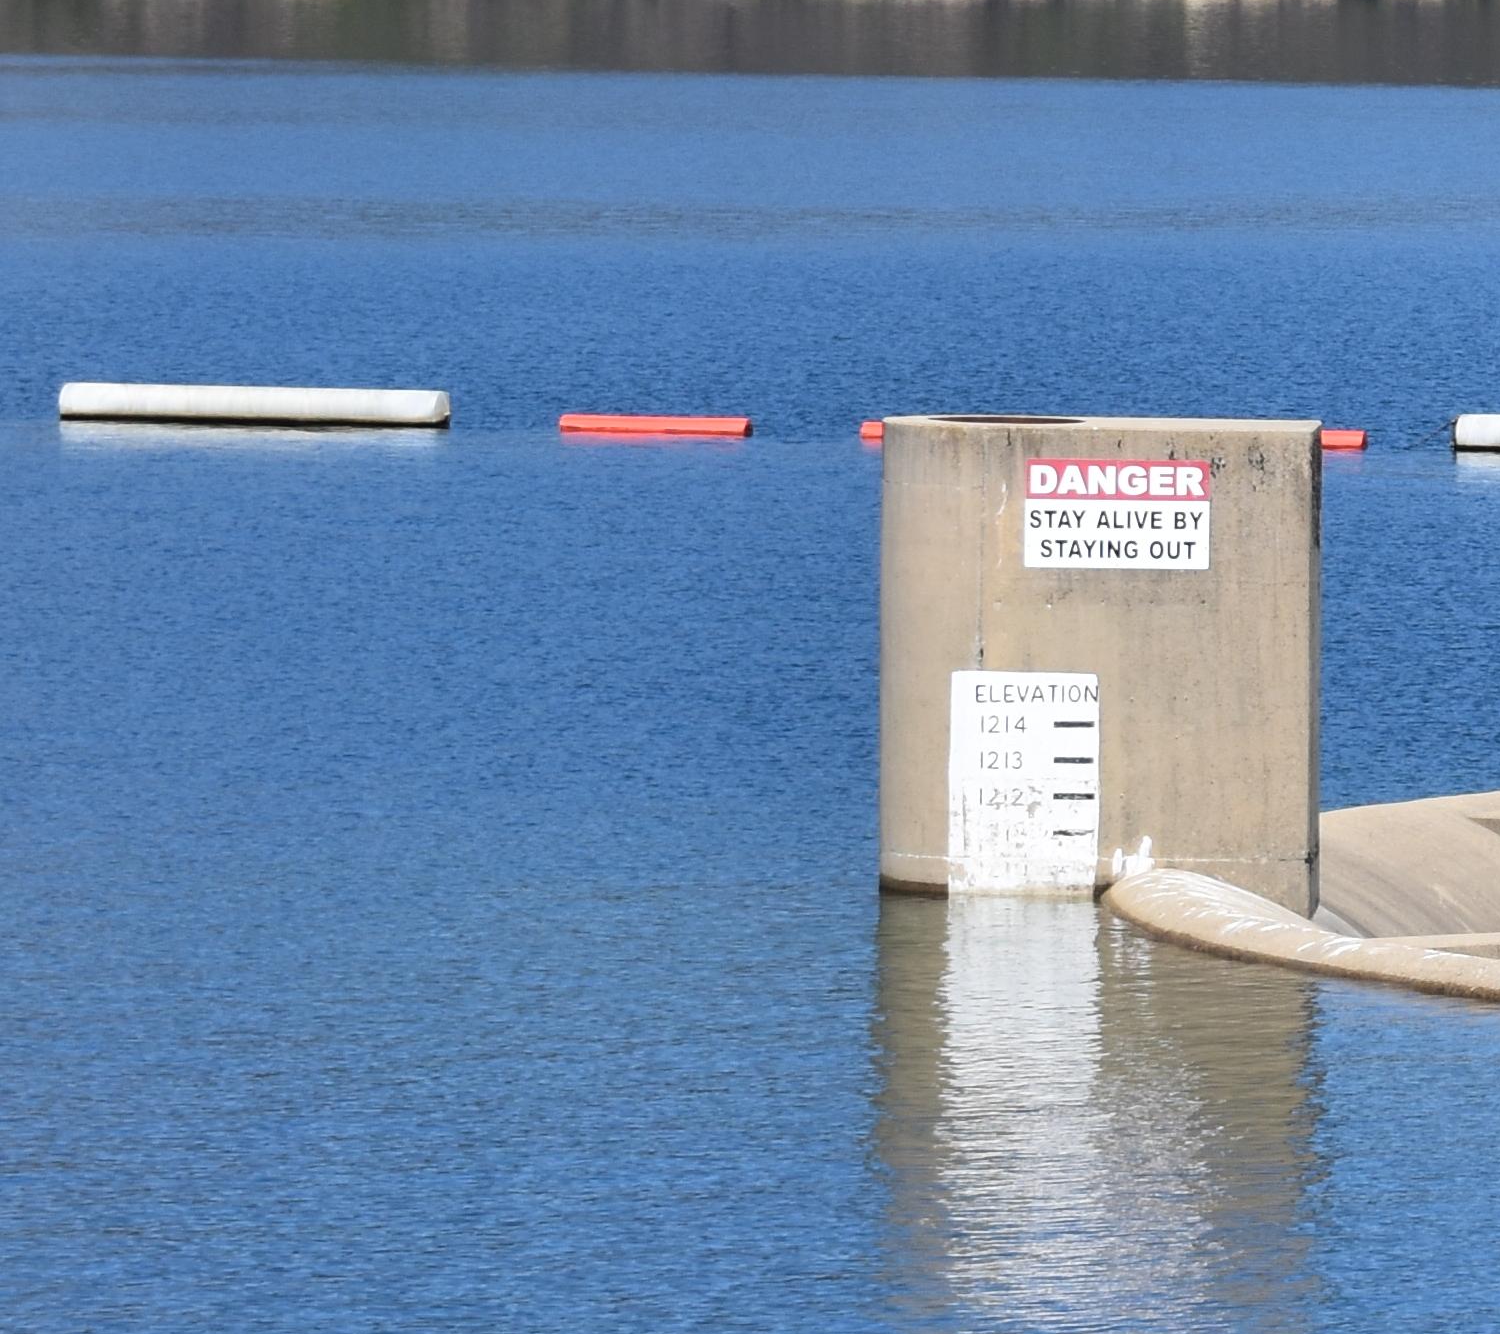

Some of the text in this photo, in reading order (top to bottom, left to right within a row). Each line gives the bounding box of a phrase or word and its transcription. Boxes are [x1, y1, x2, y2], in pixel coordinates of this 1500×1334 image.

[1030, 465, 1205, 496] DANGER
[1030, 510, 1203, 530] STAY ALIVE BY
[1041, 540, 1196, 559] STAYING OUT
[975, 684, 1099, 703] ELEVATION
[980, 715, 1027, 733] 1214
[980, 751, 1023, 769] 1213
